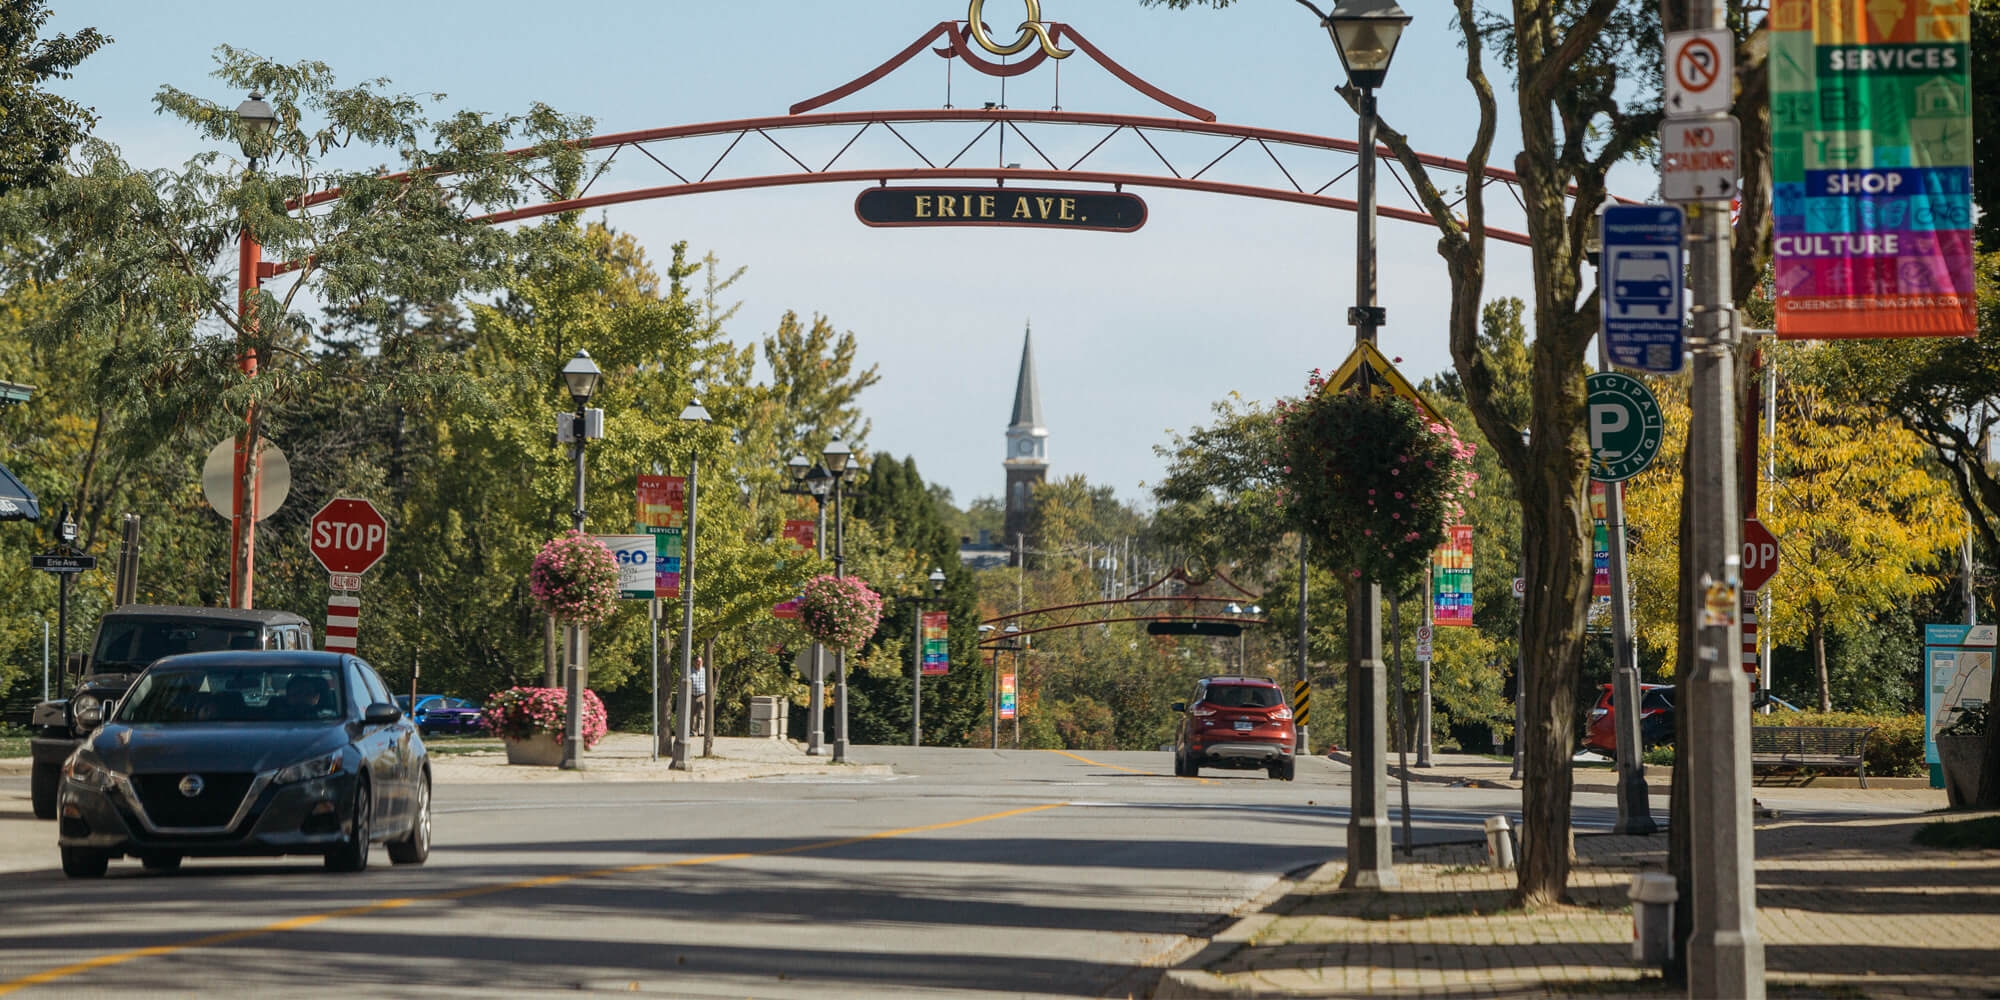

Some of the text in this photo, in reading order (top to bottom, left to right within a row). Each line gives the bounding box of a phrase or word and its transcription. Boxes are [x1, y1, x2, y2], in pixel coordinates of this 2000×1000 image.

[1829, 48, 1958, 71] SERVICES
[1683, 127, 1714, 148] NO
[1664, 150, 1735, 172] STANDING
[1826, 172, 1903, 194] SHOP
[914, 194, 1088, 222] ERIE AVE.
[1775, 234, 1899, 257] CULTURE
[1590, 403, 1630, 449] P
[314, 520, 383, 552] STOP
[649, 527, 680, 535] SERVICES
[47, 558, 79, 567] Erie Ave.
[1744, 542, 1775, 569] OP
